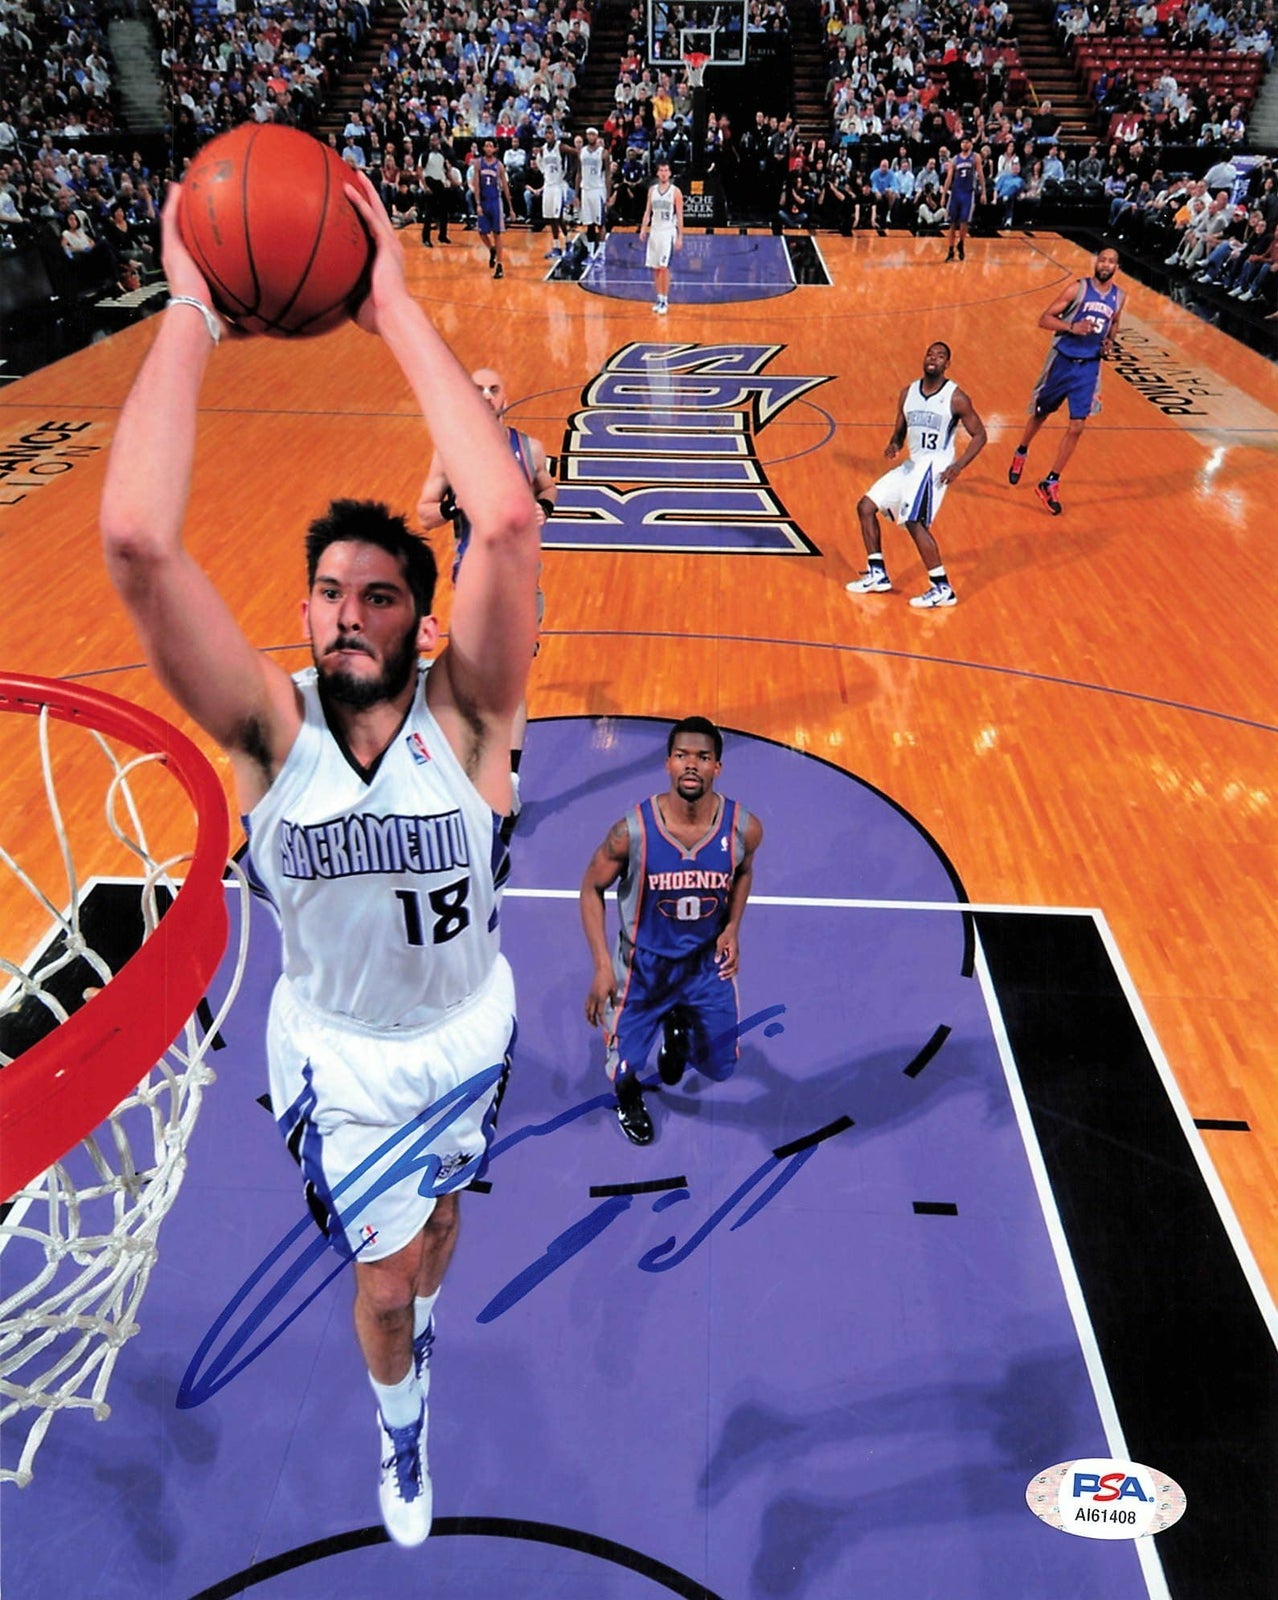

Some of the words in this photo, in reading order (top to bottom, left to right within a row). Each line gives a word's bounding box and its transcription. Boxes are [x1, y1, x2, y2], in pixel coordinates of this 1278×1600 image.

[541, 341, 839, 557] KINGS
[921, 432, 939, 451] 13
[281, 807, 470, 880] SACRAMENTO
[647, 869, 730, 891] PHOENIX
[394, 877, 470, 946] 18
[676, 895, 701, 921] 0
